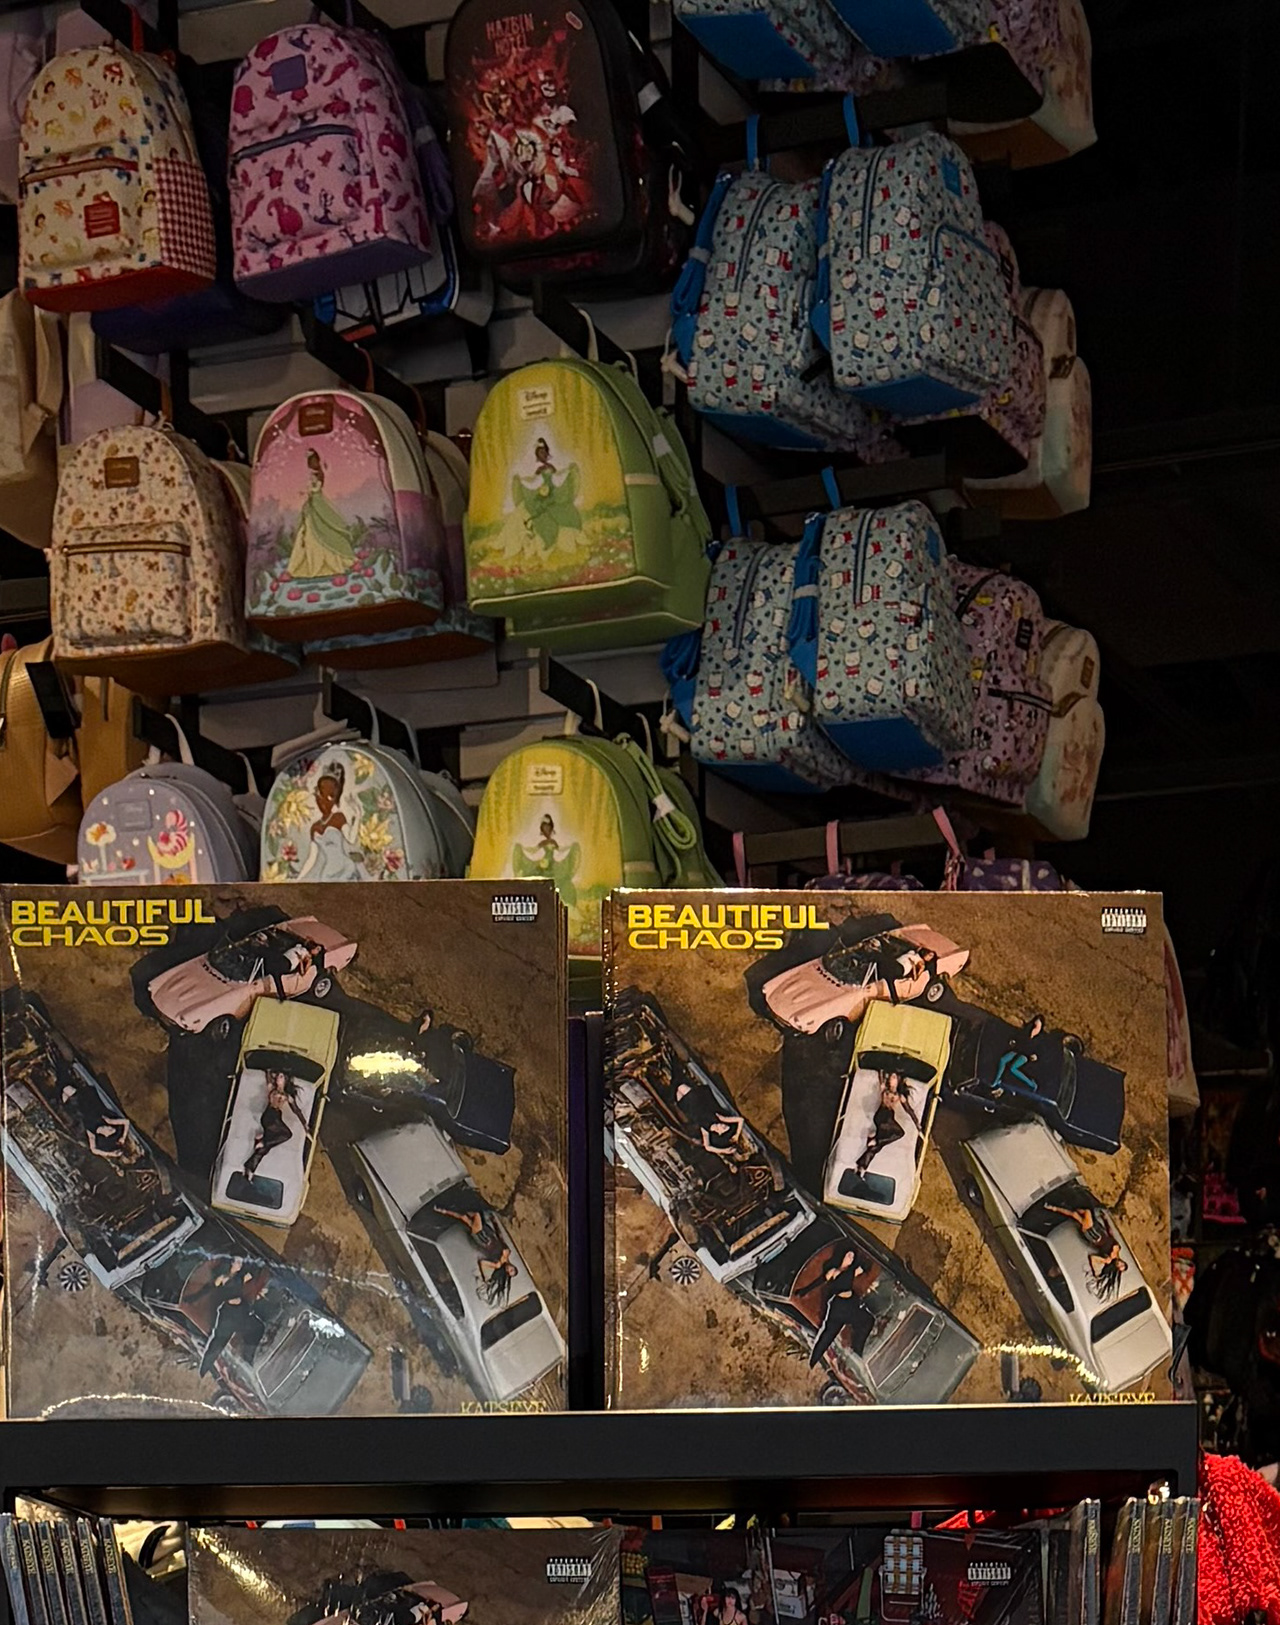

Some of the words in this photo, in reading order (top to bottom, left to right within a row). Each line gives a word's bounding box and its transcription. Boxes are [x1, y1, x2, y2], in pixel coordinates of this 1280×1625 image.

[11, 898, 216, 926] BEAUTIFUL
[627, 904, 830, 930] BEAUTIFUL
[12, 925, 169, 948] CHAOS
[629, 929, 784, 950] CHAOS
